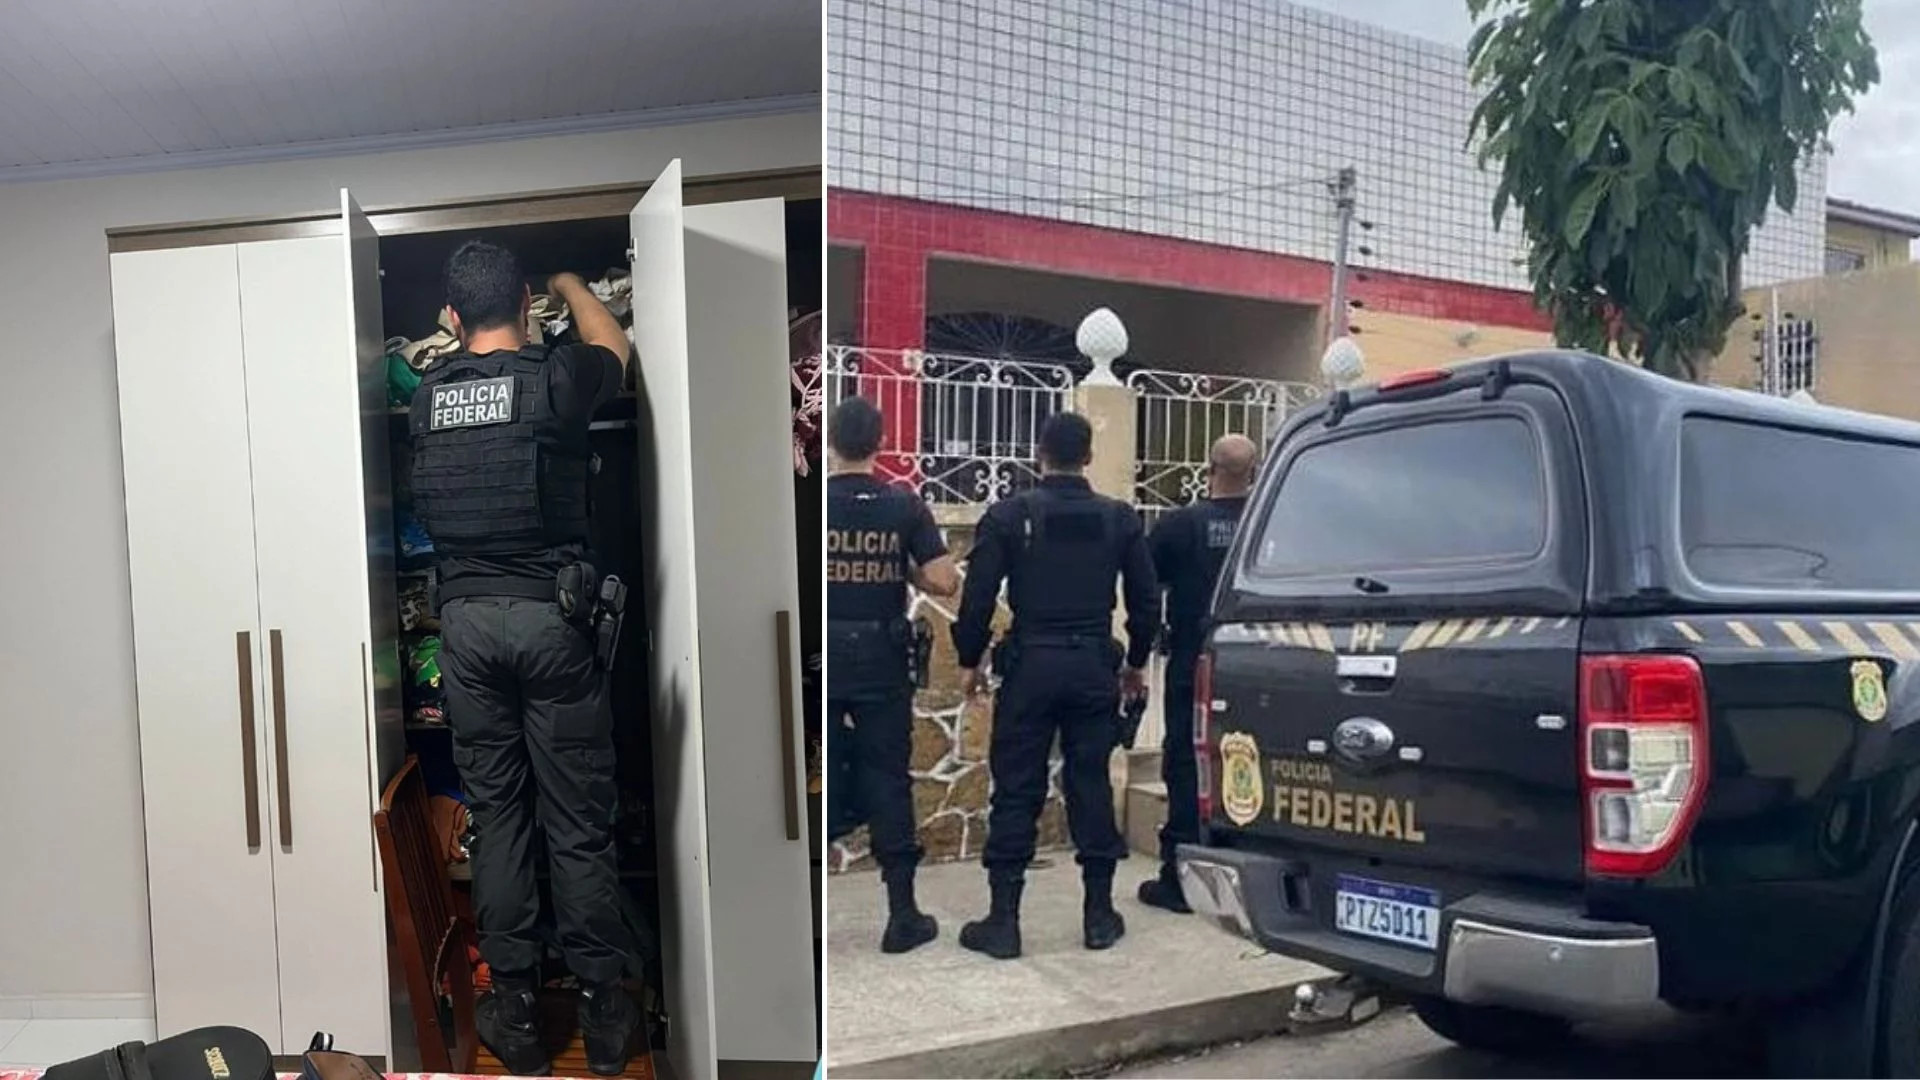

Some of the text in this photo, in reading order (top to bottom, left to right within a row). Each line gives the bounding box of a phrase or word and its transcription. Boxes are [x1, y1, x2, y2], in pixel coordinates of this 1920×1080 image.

[435, 383, 508, 408] POLÍCIA
[434, 402, 508, 427] FEDERAL
[827, 530, 900, 553] OLICIA
[827, 560, 904, 582] EDERAL
[1349, 621, 1386, 652] PF
[1272, 785, 1425, 843] FEDERAL
[1346, 895, 1428, 941] PTZ5D11
